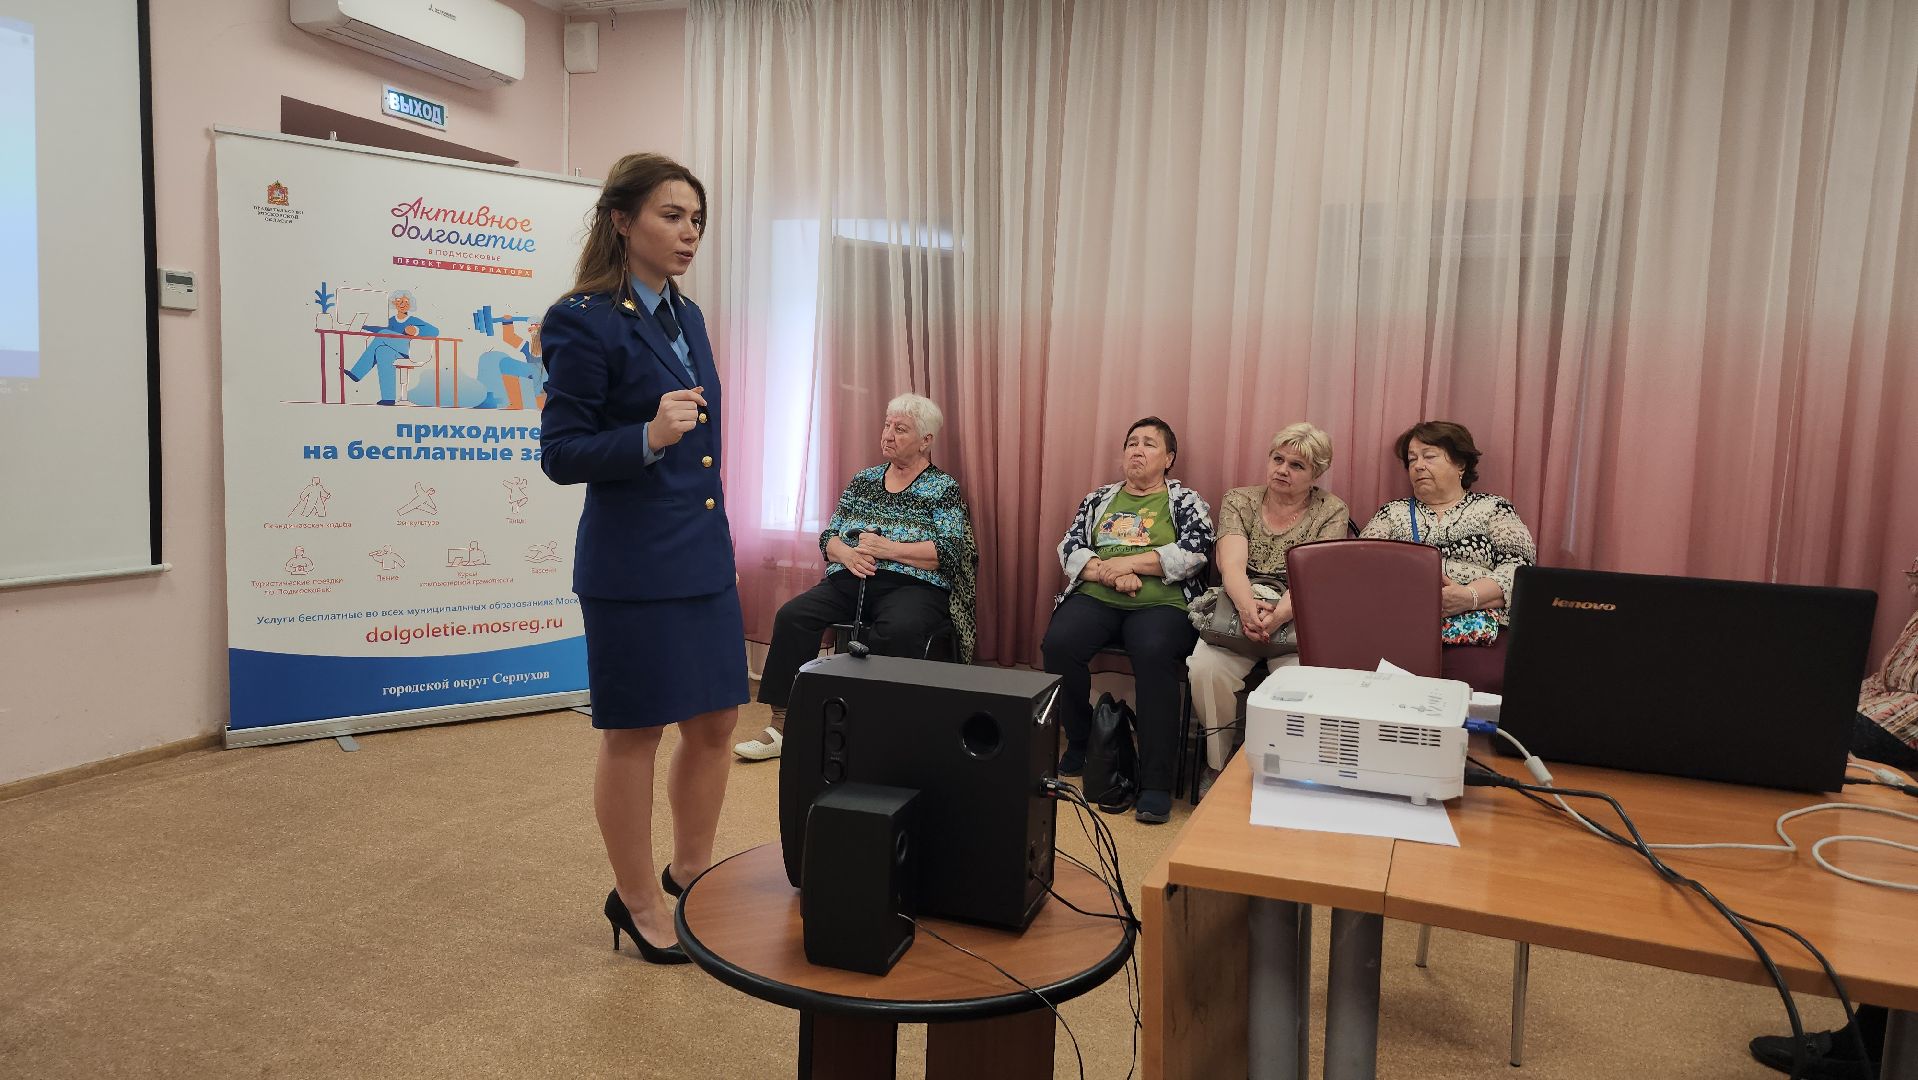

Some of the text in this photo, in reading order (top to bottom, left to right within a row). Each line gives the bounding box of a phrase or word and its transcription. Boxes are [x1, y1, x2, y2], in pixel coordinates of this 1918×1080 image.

[389, 92, 442, 124] ВЫХОД
[391, 196, 533, 233] Активное
[391, 215, 537, 253] долголетие
[397, 257, 531, 277] ПРОЕКТ ГУБЕРНАТОРА
[435, 249, 501, 262] ПОДМОСКОВЬЕ
[396, 423, 541, 443] приходите
[303, 445, 338, 460] на
[347, 440, 513, 461] бесплатные
[257, 615, 295, 626] Услуги
[298, 611, 363, 623] бесплатные
[366, 610, 379, 618] во
[381, 608, 404, 617] всех
[407, 603, 486, 617] муниципальных
[489, 600, 553, 612] образованиях
[1552, 597, 1616, 611] lenovo
[366, 616, 563, 645] dolgoletie.mosreg.ru
[382, 670, 550, 697] городской округ Серпухов
